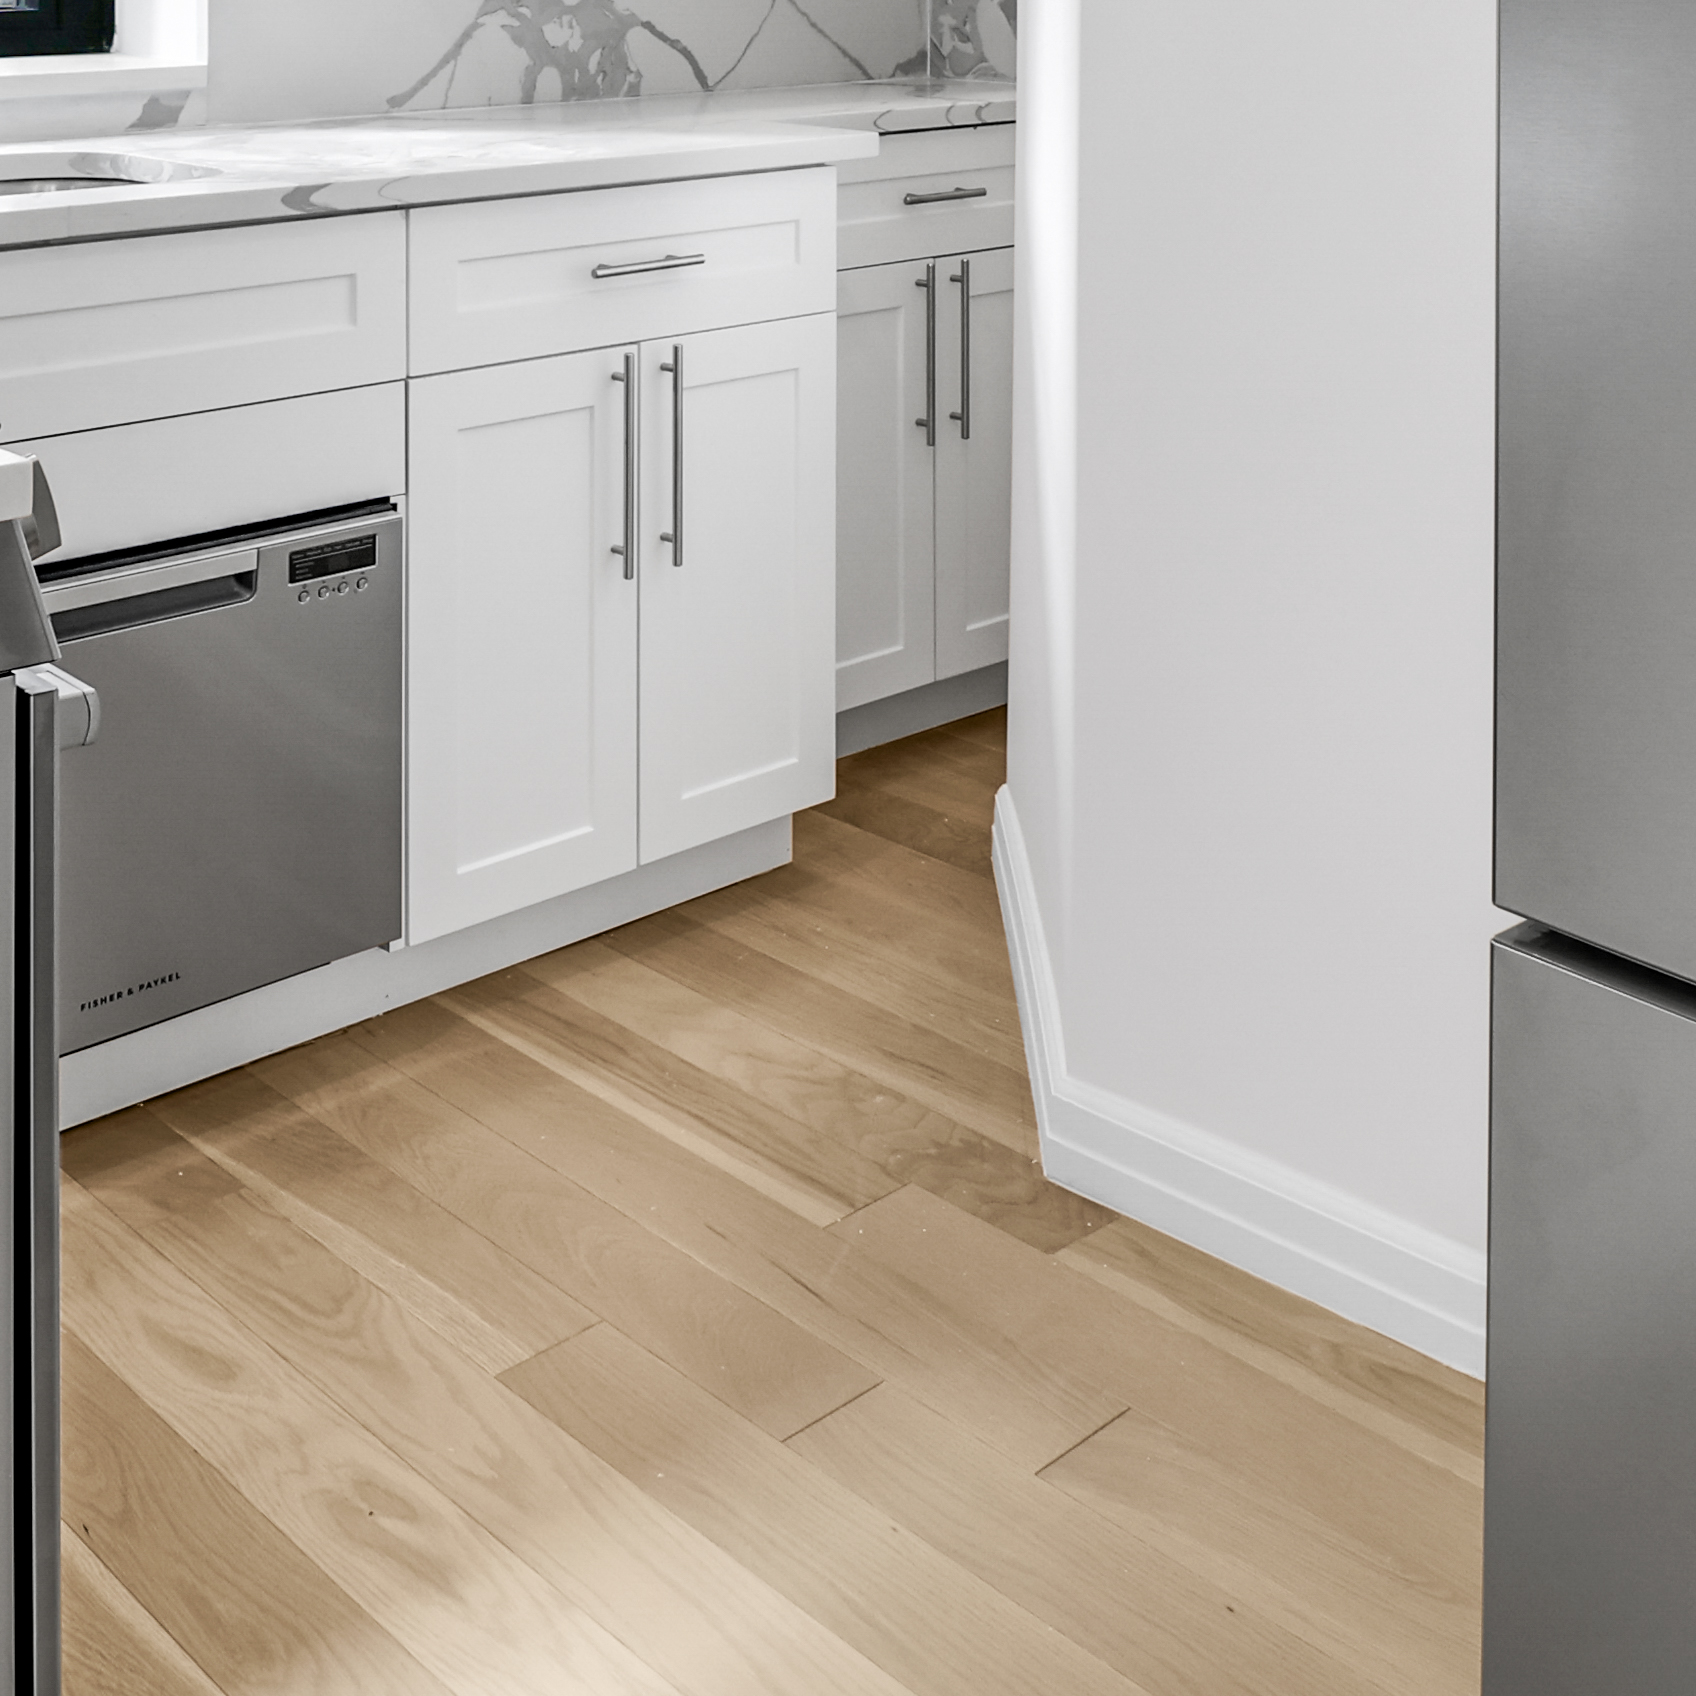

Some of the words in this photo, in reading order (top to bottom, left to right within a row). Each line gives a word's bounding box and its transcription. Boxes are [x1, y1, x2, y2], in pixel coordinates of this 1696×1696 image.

[80, 991, 123, 1012] FISHER
[127, 987, 134, 996] &
[138, 972, 181, 992] PAYKEL
